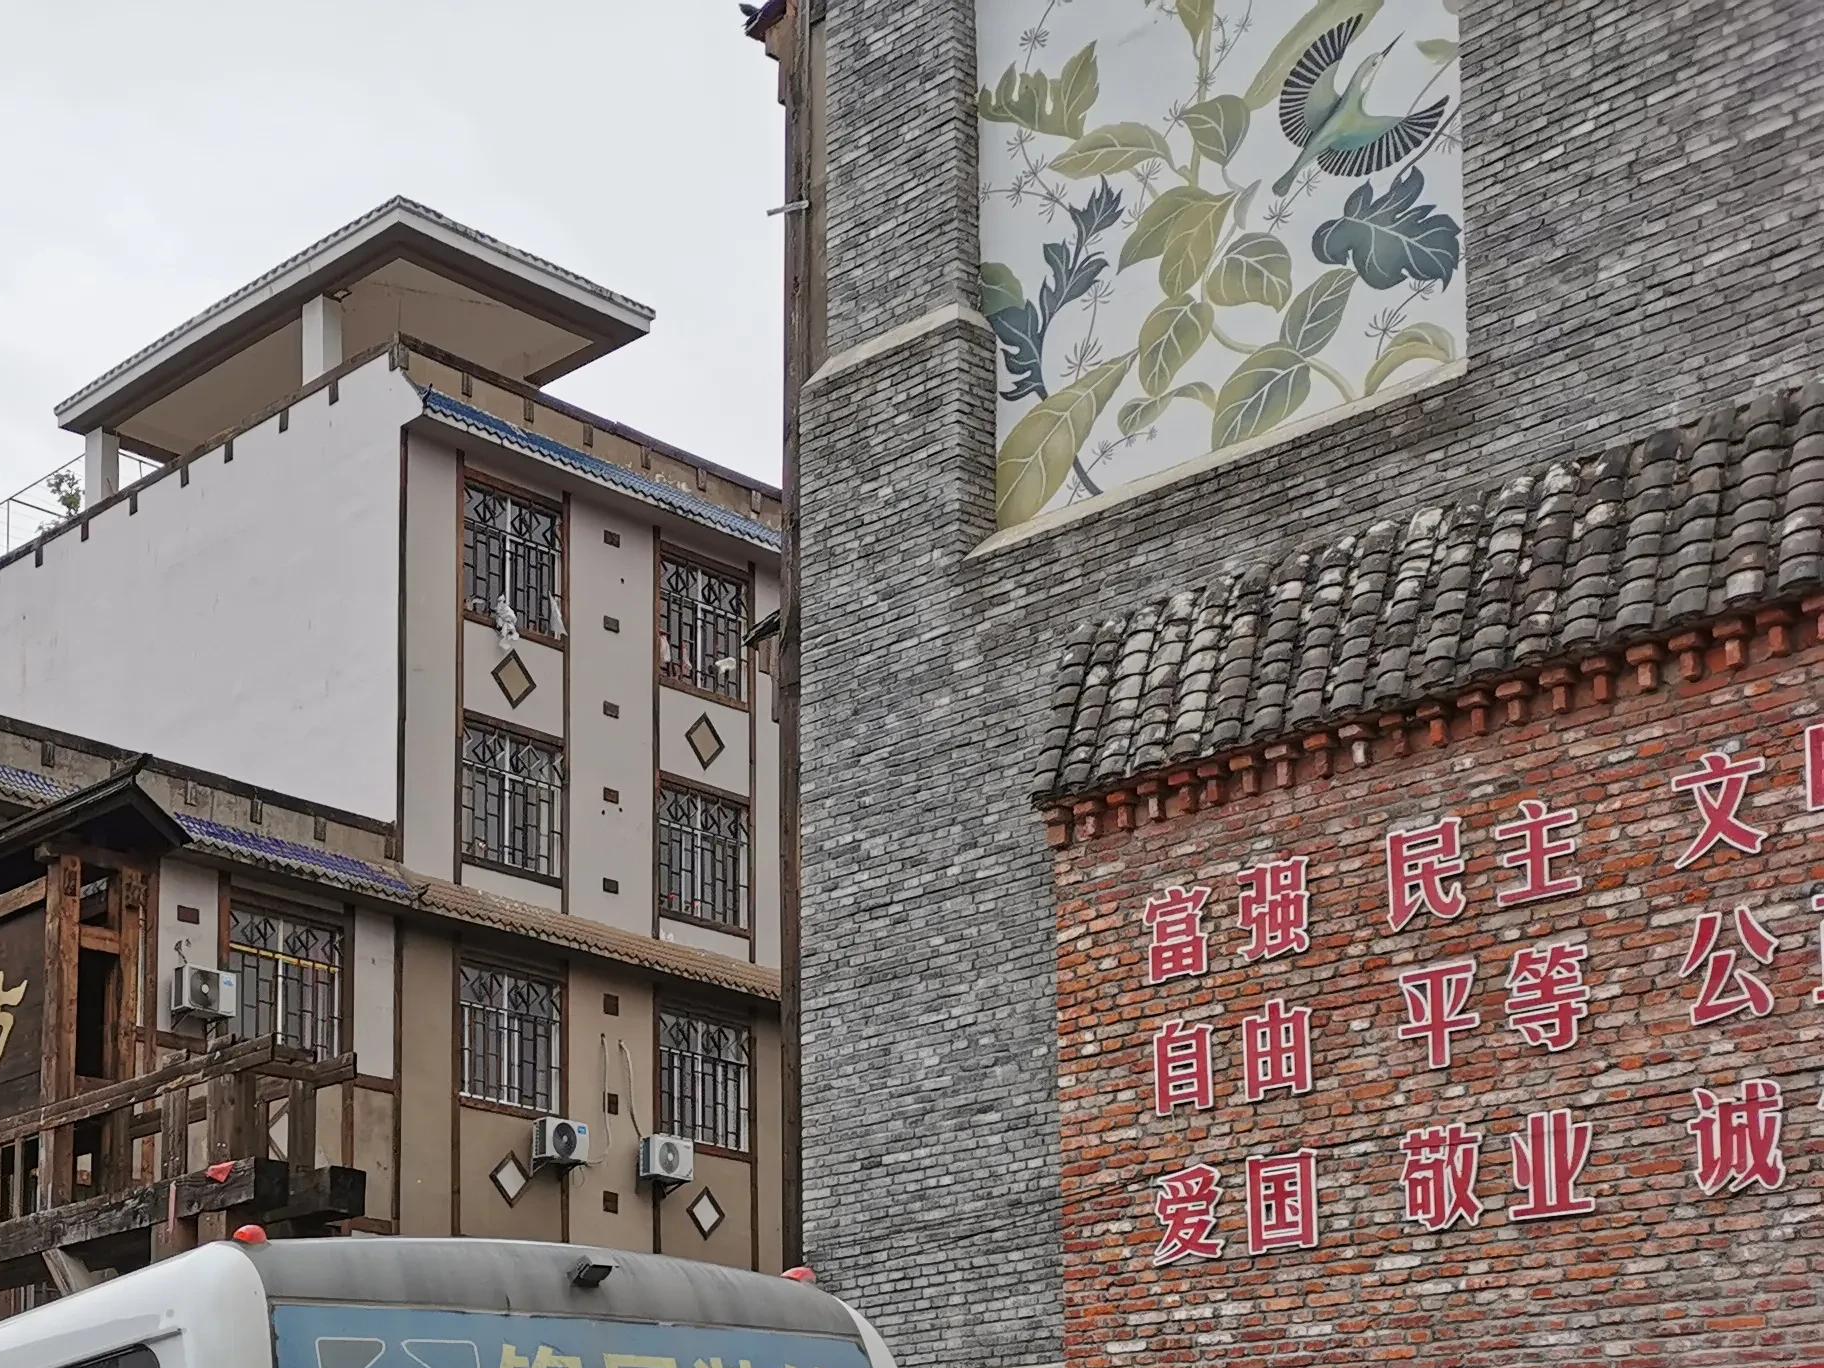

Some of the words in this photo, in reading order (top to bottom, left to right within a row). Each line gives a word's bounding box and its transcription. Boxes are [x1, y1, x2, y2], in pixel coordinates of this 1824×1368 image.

[1142, 855, 1311, 985] 富强
[1384, 798, 1583, 932] 民主
[1671, 722, 1824, 869] 文
[1152, 998, 1314, 1117] 自由
[1397, 942, 1590, 1069] 平等
[1677, 892, 1824, 1027] 公
[1152, 1147, 1318, 1267] 爱国
[1398, 1107, 1596, 1231] 敬业
[1686, 1068, 1824, 1196] 诚
